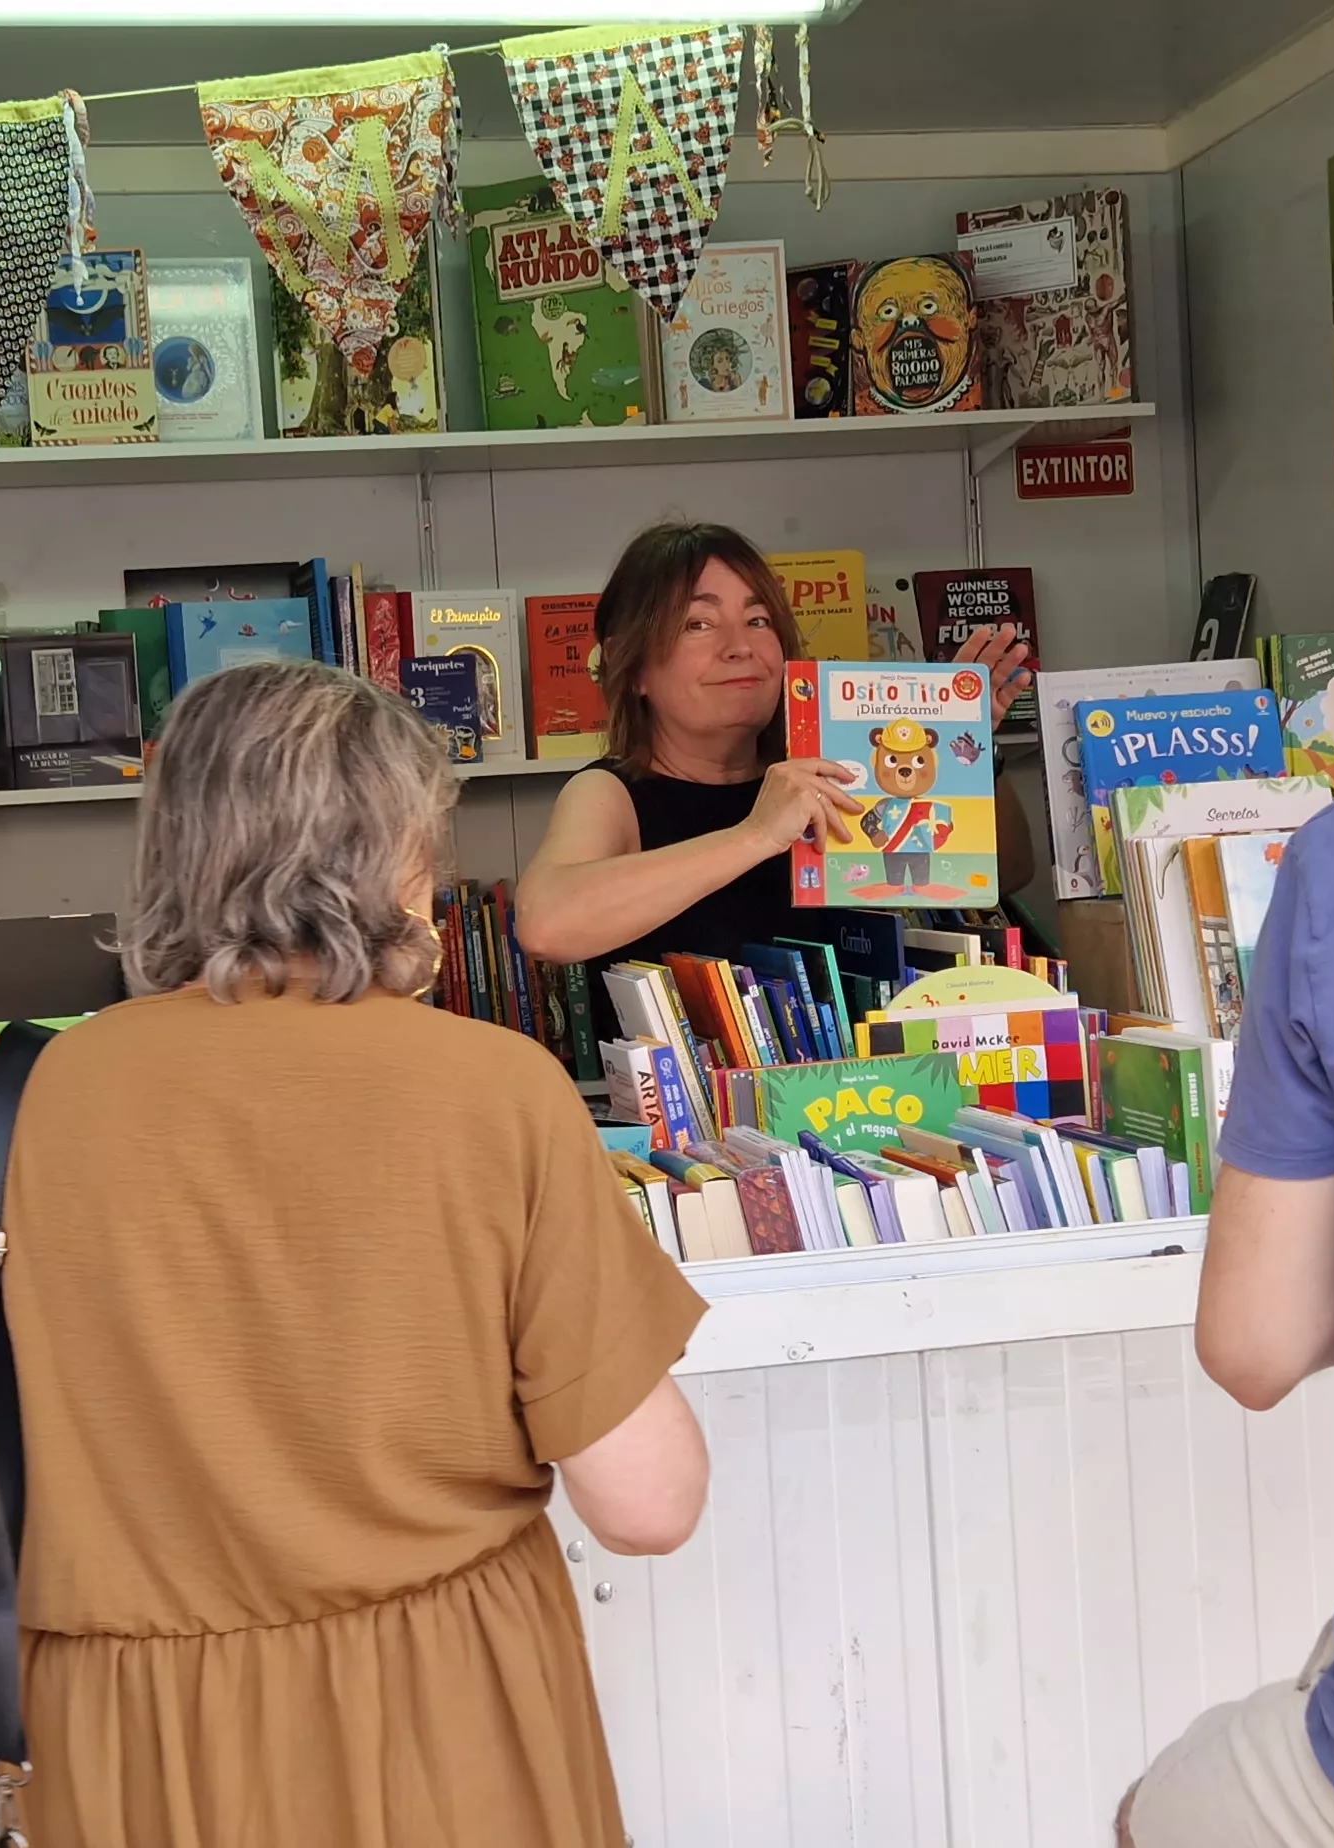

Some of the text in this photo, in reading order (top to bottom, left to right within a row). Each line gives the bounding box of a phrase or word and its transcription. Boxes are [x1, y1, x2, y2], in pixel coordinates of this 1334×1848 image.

[235, 113, 415, 296] M
[587, 66, 719, 239] A
[500, 249, 600, 290] MUNDO
[700, 300, 765, 319] Griegos
[904, 339, 923, 350] MIS
[891, 348, 937, 361] PRIMERAS
[46, 376, 138, 402] Cuentos
[895, 373, 939, 388] PALABRAS
[71, 400, 139, 425] miedo
[1022, 455, 1128, 486] EXTINTOR
[946, 580, 1008, 592] GUINNESS
[947, 591, 1009, 606] WORLD
[430, 605, 502, 625] El Principito
[804, 607, 853, 617] SIETE MARES
[948, 604, 1011, 618] RECORDS
[566, 623, 589, 634] VACA
[1196, 618, 1220, 662] a
[411, 660, 465, 676] Periquetes
[410, 687, 426, 708] 3
[842, 680, 950, 702] Osito Tito
[856, 703, 944, 717] ¡Disfrázame!
[1126, 704, 1232, 722] Muevo y escucho
[39, 760, 70, 768] MUNDO
[1206, 808, 1260, 822] Secretos
[932, 1034, 1021, 1051] David McKee
[958, 1047, 1042, 1086] MER
[803, 1086, 924, 1133] PACO
[833, 1133, 843, 1147] y
[846, 1123, 856, 1137] el
